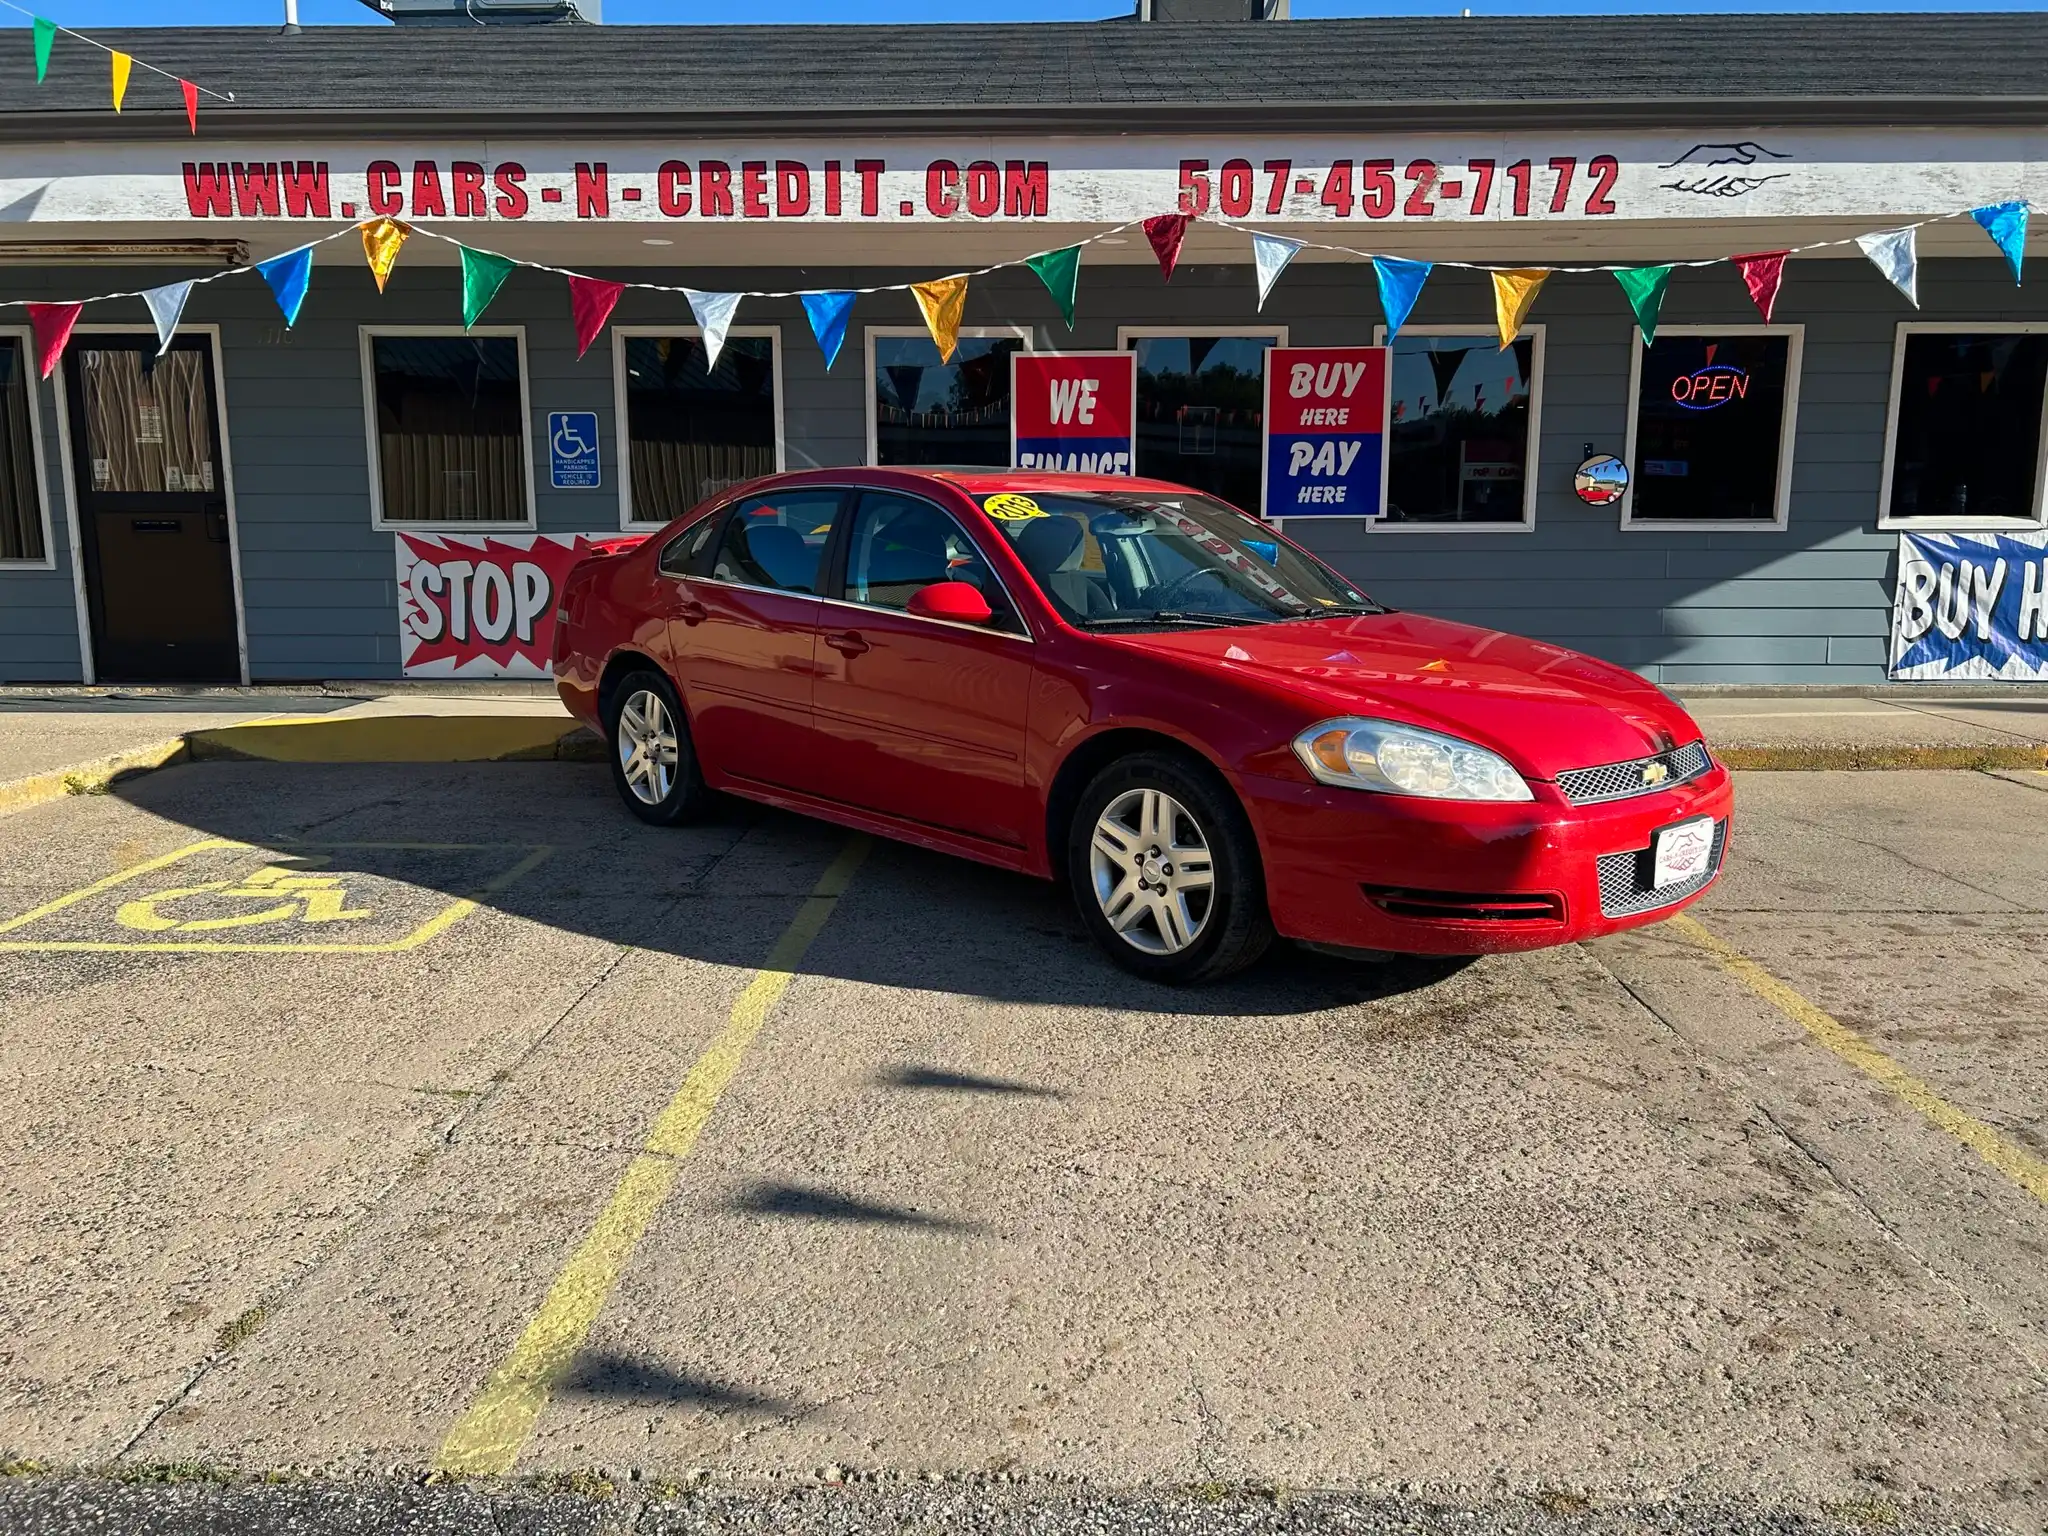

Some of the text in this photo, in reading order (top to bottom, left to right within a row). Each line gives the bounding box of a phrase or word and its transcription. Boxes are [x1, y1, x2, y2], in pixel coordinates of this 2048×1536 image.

[1177, 154, 1620, 219] 507-452-7172
[1288, 361, 1367, 399] BUY
[1671, 374, 1750, 400] OPEN
[1049, 378, 1100, 426] WE
[1300, 407, 1349, 427] HERE
[1288, 440, 1362, 477] PAY
[992, 496, 1036, 518] 2013
[1298, 486, 1347, 504] HERE
[407, 559, 553, 645] STOP
[1901, 557, 2007, 643] BUY
